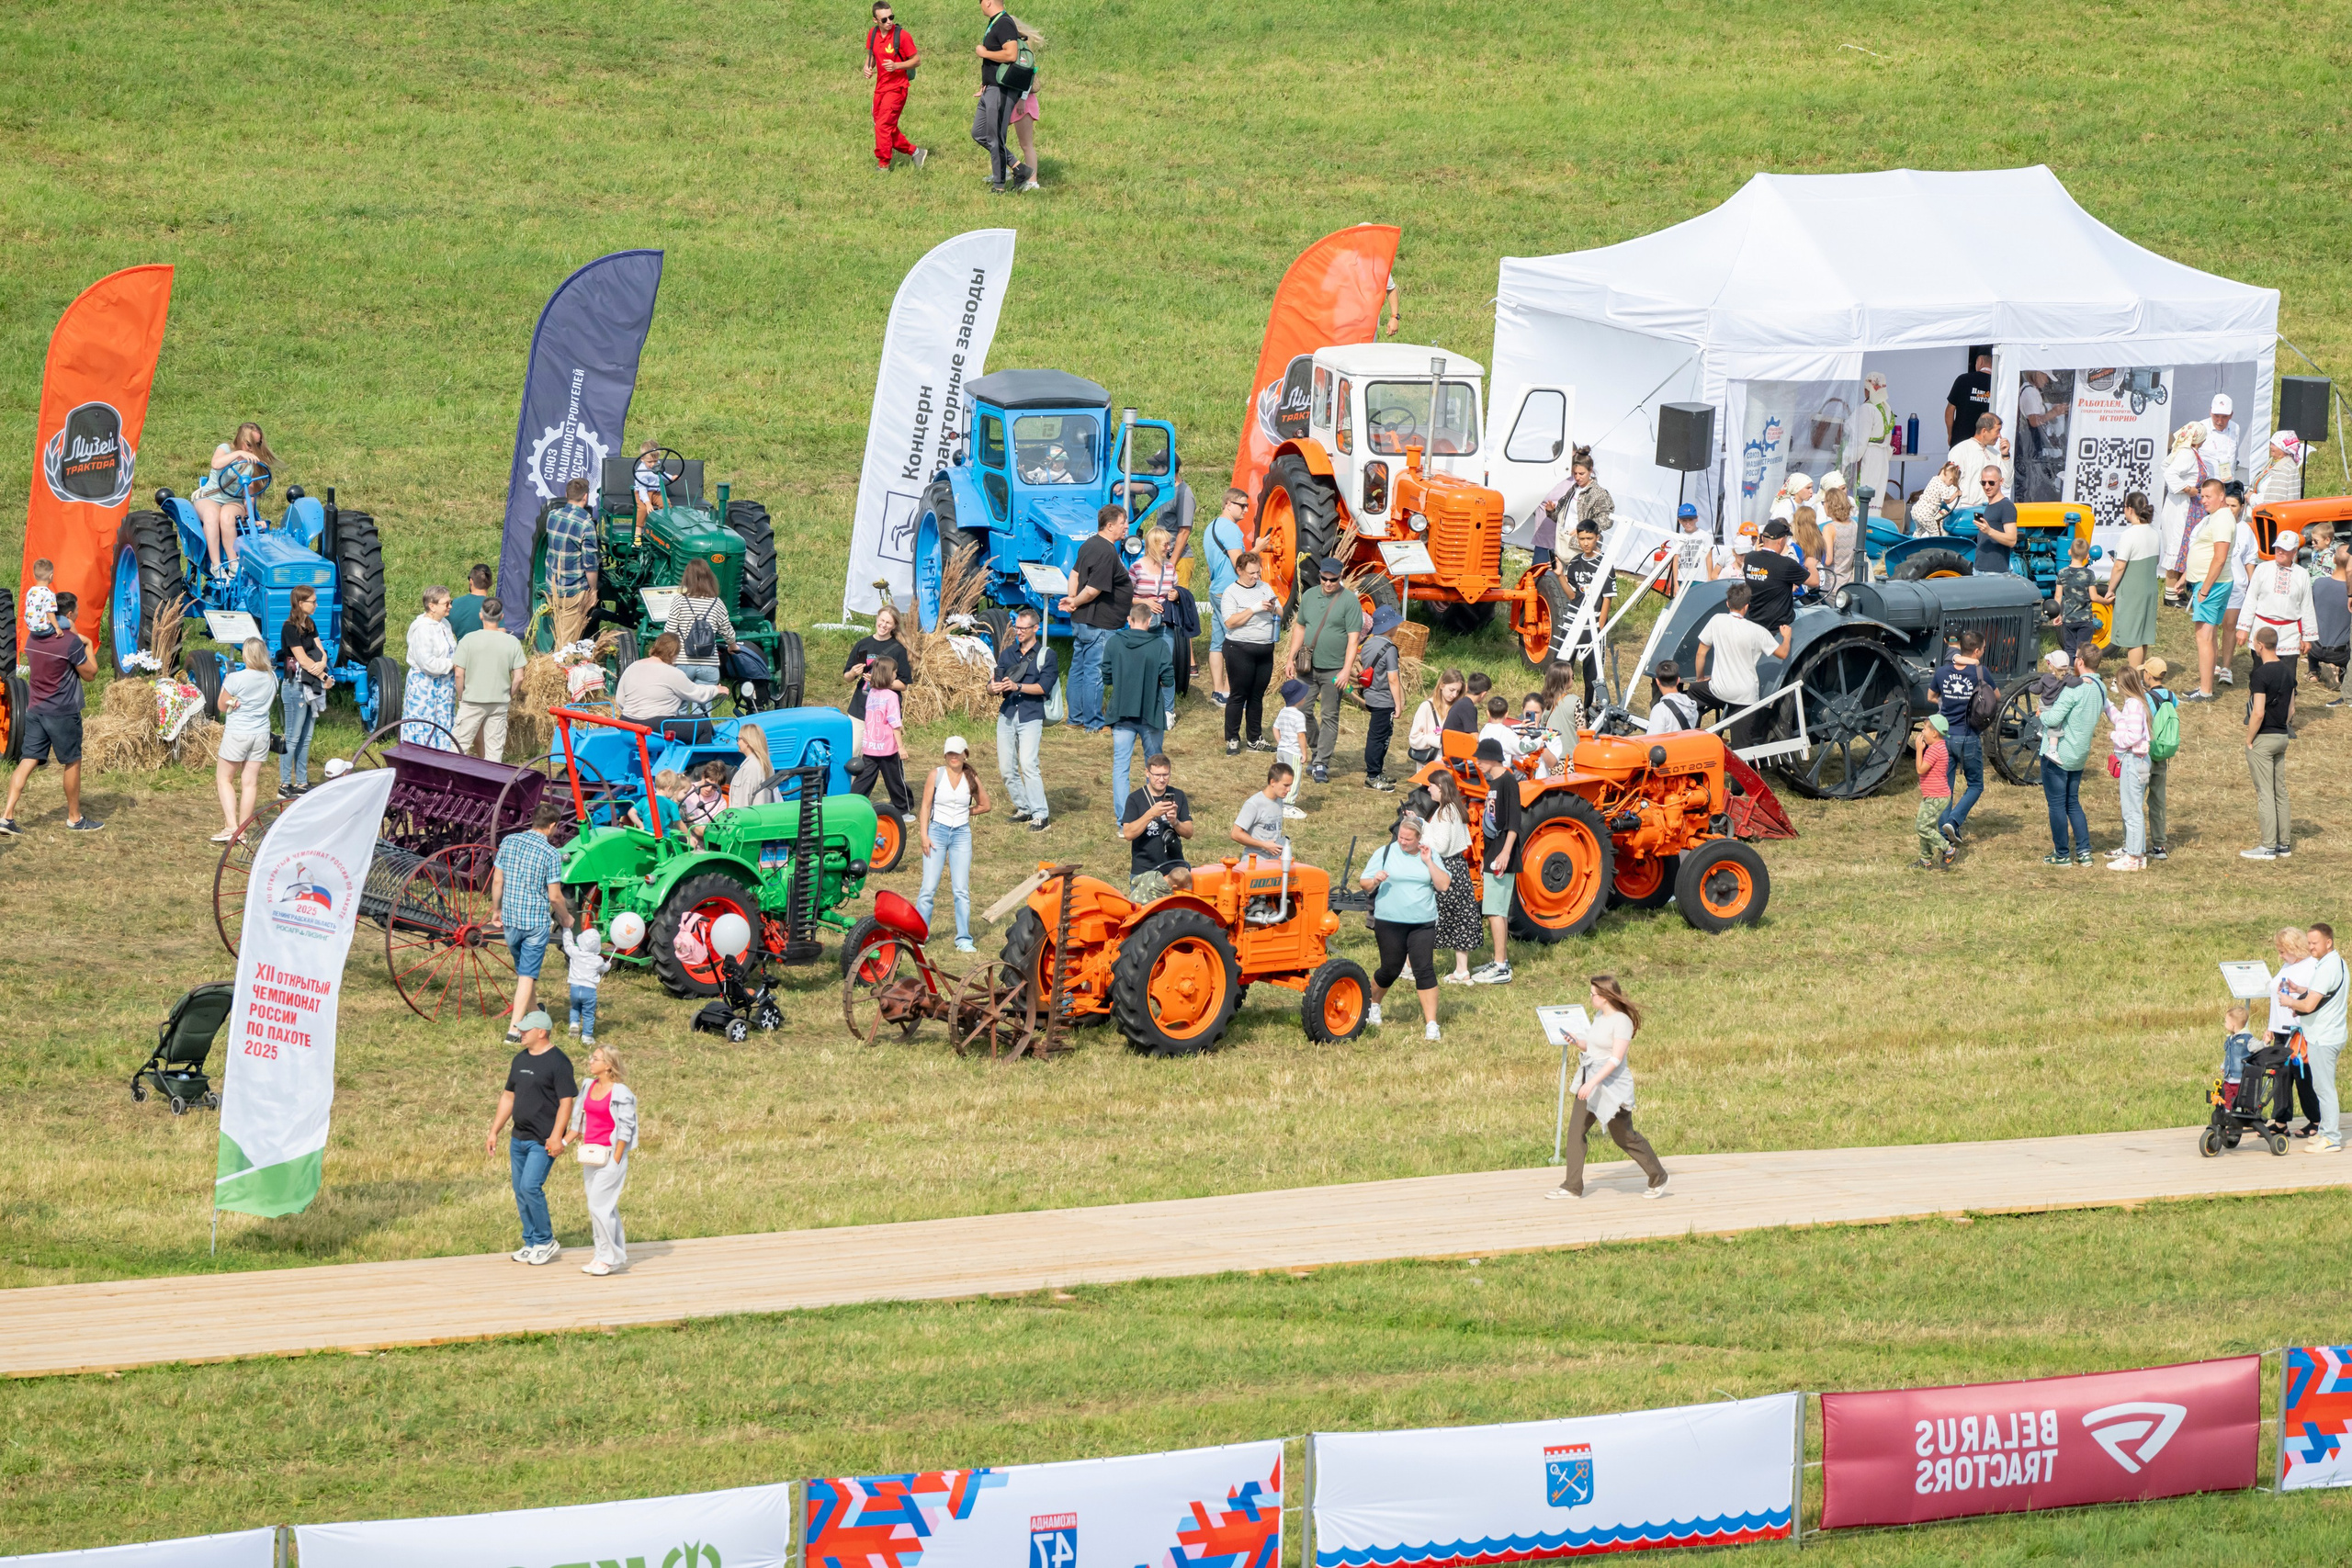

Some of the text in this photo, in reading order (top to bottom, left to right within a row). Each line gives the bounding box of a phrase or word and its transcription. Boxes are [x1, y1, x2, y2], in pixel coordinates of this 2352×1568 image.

[956, 267, 986, 350] заводы
[557, 368, 585, 483] МАШИНОСТРОИТЕЛЕЙ
[901, 385, 933, 480] Концерн
[63, 432, 118, 463] Музей
[65, 458, 115, 476] ТРАКТОРА
[544, 448, 558, 480] СОЮЗ
[569, 444, 584, 481] ОССИИ
[868, 741, 885, 750] PLAY
[1688, 762, 1703, 772] 20
[292, 850, 330, 860] ЧЕМПИОНАТ
[266, 855, 291, 891] ОТКРЫТЫЙ
[330, 856, 350, 880] РОССИИ
[345, 881, 354, 891] ПО
[1250, 876, 1283, 889] FIAT
[296, 904, 318, 916] 2025
[338, 893, 353, 919] ПАХОТЕ
[272, 909, 337, 930] ЛЕНИНГРАДСКАЯ ОБЛАСТЬ
[277, 971, 332, 996] ОТКРЫТЫЙ
[253, 984, 322, 1013] ЧЕМПИОНАТ
[249, 1002, 298, 1026] РОССИИ
[246, 1021, 311, 1047] ПО ПАХОТЕ
[243, 1040, 278, 1060] 2025
